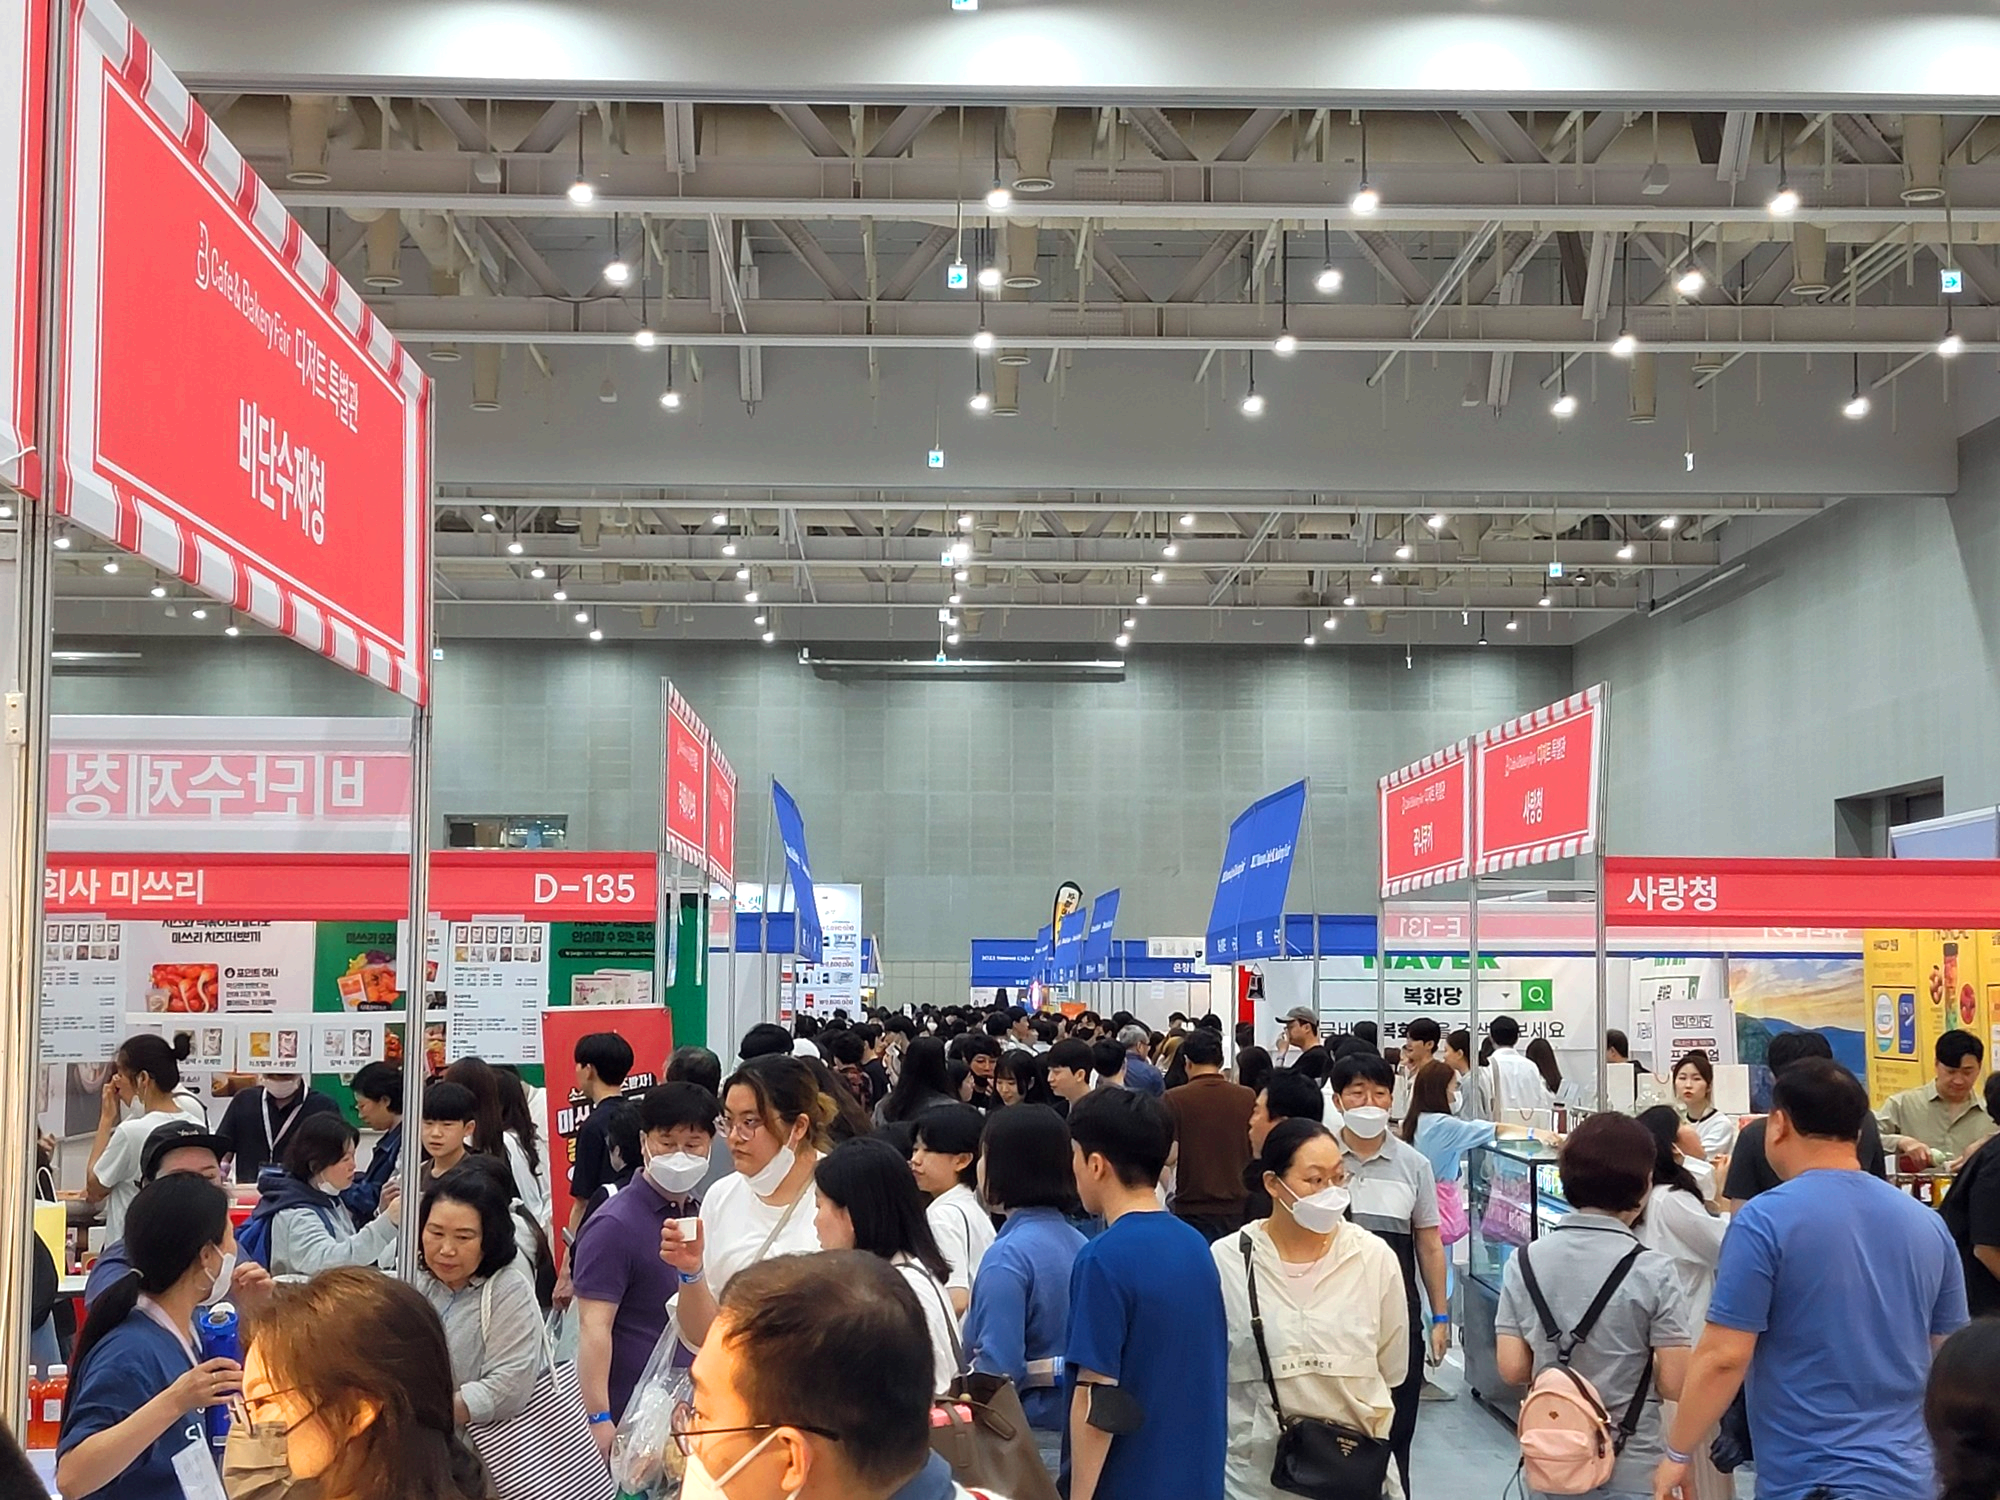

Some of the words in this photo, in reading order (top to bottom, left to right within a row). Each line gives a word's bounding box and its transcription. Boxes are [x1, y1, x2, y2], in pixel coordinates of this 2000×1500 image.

[295, 327, 326, 400] 디저트
[328, 359, 358, 434] 특별관
[239, 398, 325, 545] 비단수제청
[111, 868, 204, 904] 미쓰리
[534, 873, 635, 904] D-135
[1627, 876, 1718, 911] 사랑청
[171, 931, 202, 943] 미쓰리
[1404, 987, 1462, 1006] 복화당
